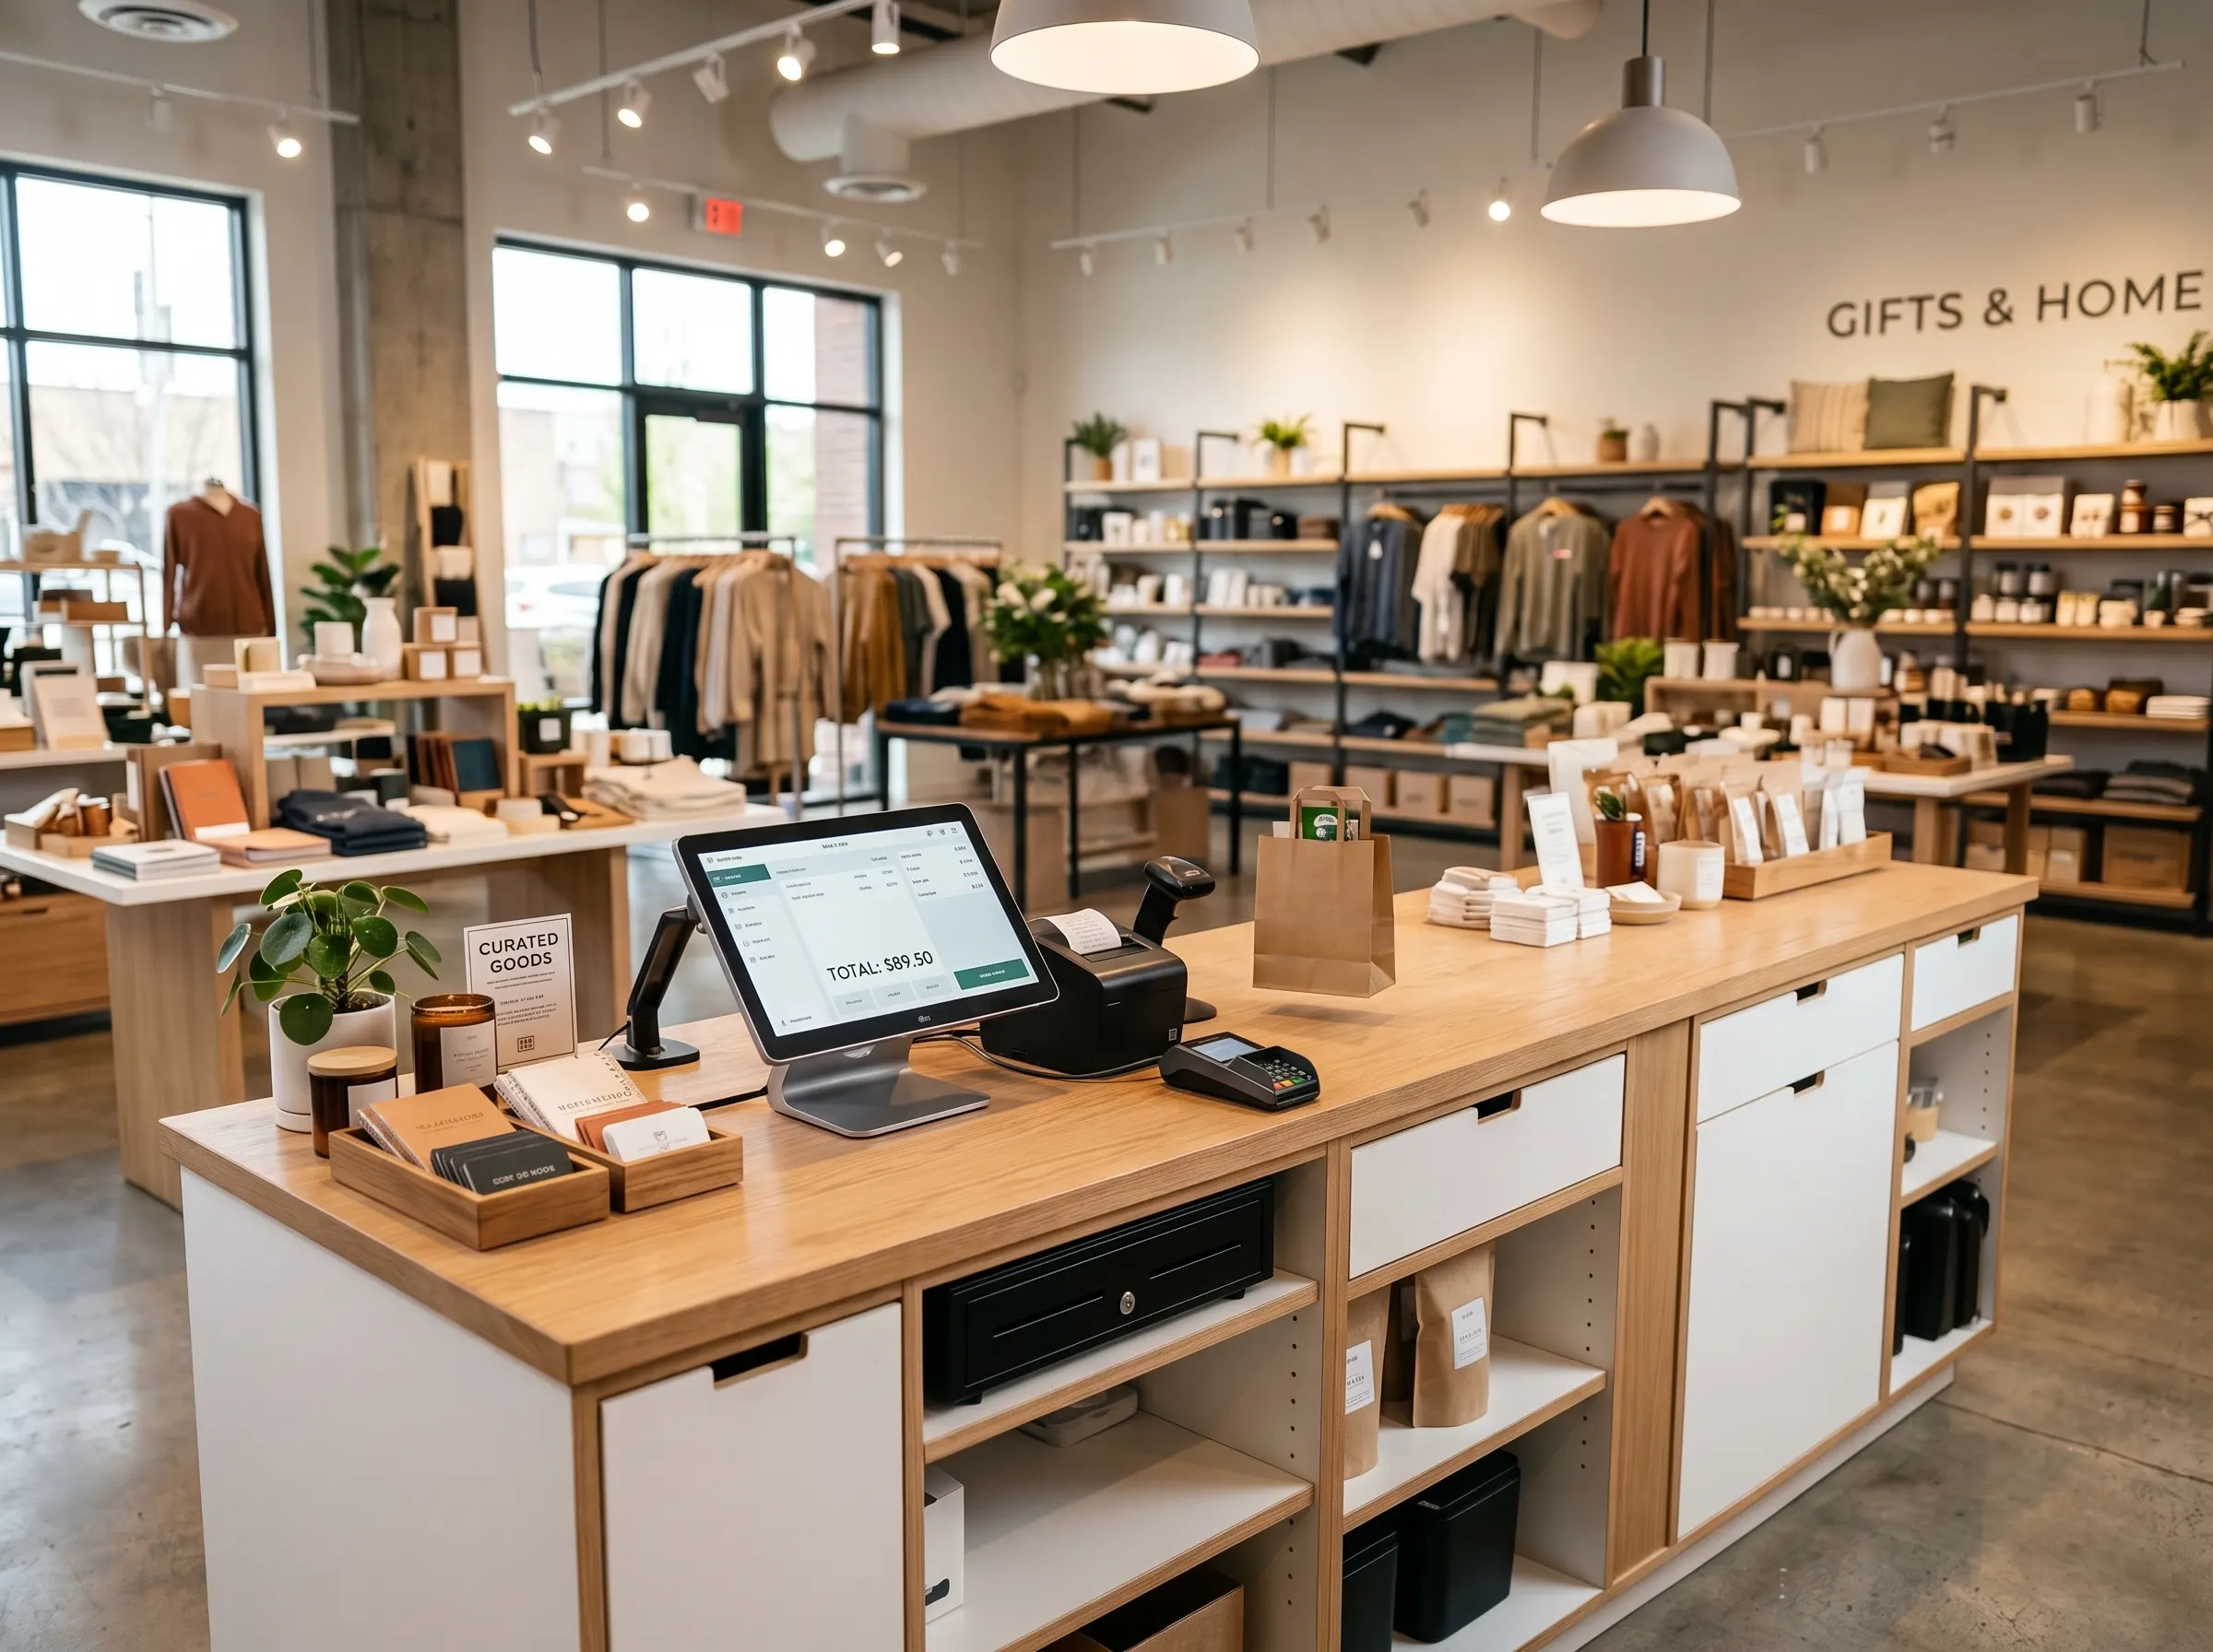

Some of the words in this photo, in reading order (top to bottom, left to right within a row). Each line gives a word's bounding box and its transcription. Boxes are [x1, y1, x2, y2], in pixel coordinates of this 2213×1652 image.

[1827, 292, 1963, 339] GIFTS
[1982, 289, 2014, 327] &
[2037, 269, 2204, 323] HOME
[479, 932, 559, 955] CURATED
[490, 952, 552, 974] GOODS
[826, 962, 882, 981] TOTAL:
[883, 950, 933, 972] $89.50
